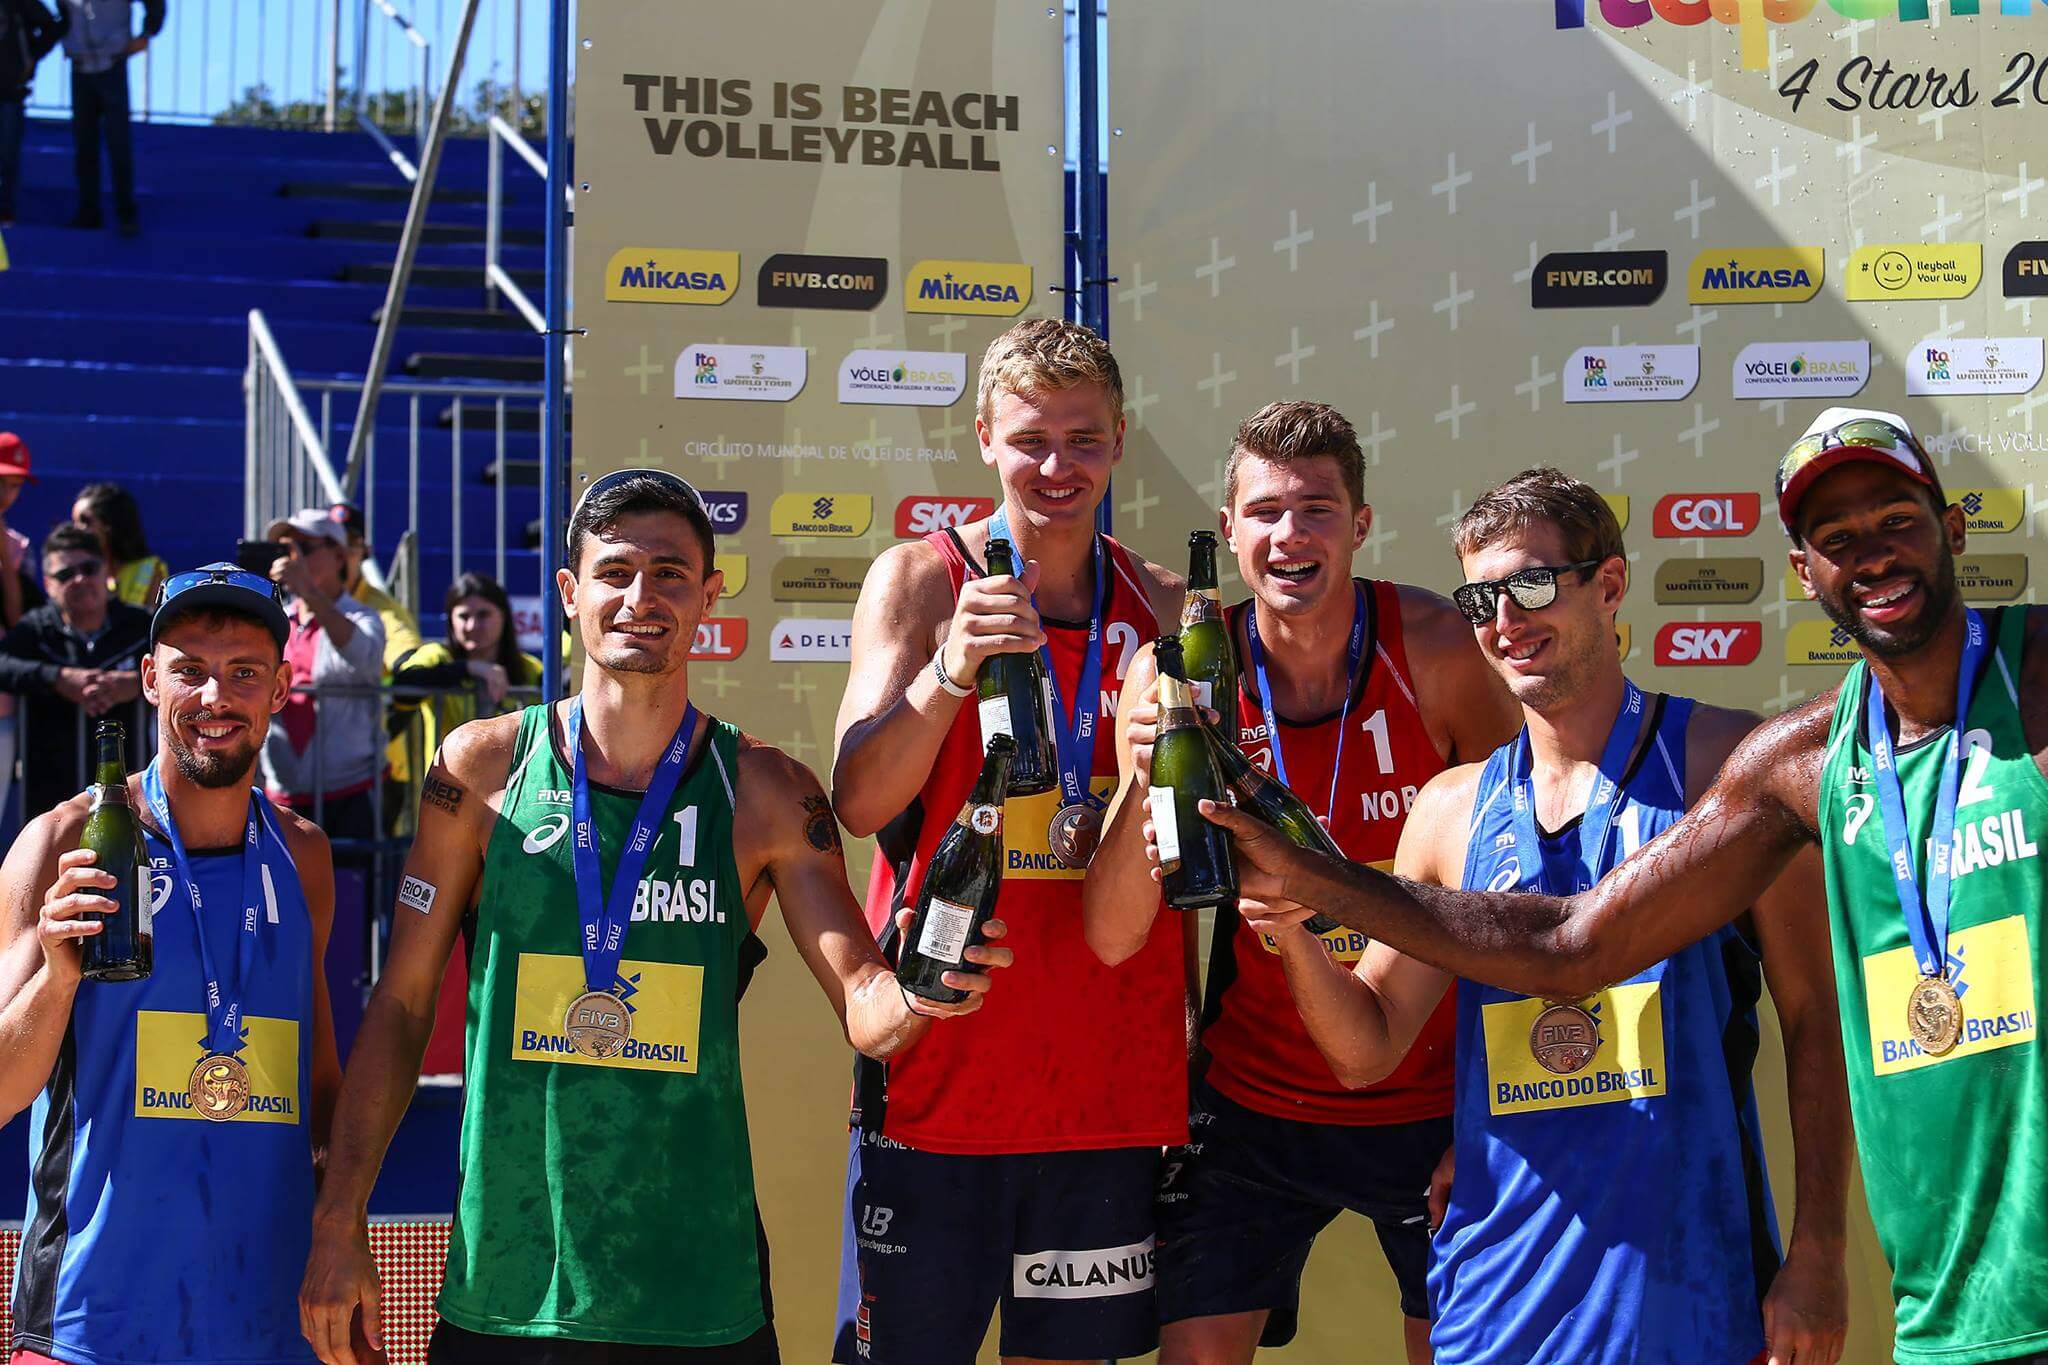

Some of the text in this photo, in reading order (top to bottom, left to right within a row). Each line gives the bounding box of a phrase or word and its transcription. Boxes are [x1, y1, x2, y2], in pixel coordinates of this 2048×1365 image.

[1778, 58, 1820, 113] 4
[1826, 55, 1979, 113] Stars
[622, 73, 1019, 131] THIS IS BEACH
[643, 117, 1000, 172] VOLLEYBALL
[772, 271, 875, 290] FIVB.COM
[1546, 268, 1654, 288] FIVB.COM
[1916, 272, 1967, 285] Your Way
[850, 367, 956, 384] VÔLEI BRASIL
[1744, 361, 1859, 376] VÔLEI BRASIL
[684, 441, 754, 457] CIRCUITO
[757, 444, 825, 460] MUNDIAL
[829, 446, 847, 460] DE
[895, 447, 913, 461] DE
[917, 448, 958, 463] PRAIA
[1924, 433, 1992, 453] BEACH
[706, 503, 738, 522] ICS
[909, 502, 976, 533] SKY
[1670, 499, 1744, 531] GOL
[1978, 520, 2004, 529] BRASIL
[792, 522, 817, 532] BANCO
[829, 523, 853, 533] BRASIL
[782, 580, 827, 589] WORLD
[1666, 582, 1749, 591] WORLD TOUR
[1980, 579, 2013, 587] TOUR
[690, 624, 732, 654] OL
[801, 634, 852, 648] DELT
[1089, 619, 1097, 641] FIVB
[1668, 628, 1742, 660] SKY
[1808, 651, 1835, 660] BANCO
[1631, 690, 1641, 714] FIVB
[1082, 712, 1093, 738] FIVB
[671, 740, 687, 764] FIVB
[1362, 709, 1394, 774] 1
[1960, 728, 1993, 807] 2
[537, 789, 571, 801] FIVB
[1064, 771, 1078, 797] FIVB
[1361, 785, 1418, 820] NOR
[577, 822, 588, 848] FIVB
[634, 827, 651, 852] FIVB
[673, 805, 698, 867] 1
[1612, 805, 1640, 860] 1
[1926, 808, 2038, 882] RASIL
[149, 858, 168, 868] VB
[403, 880, 423, 898] RIO
[244, 907, 256, 933] FIVB
[586, 923, 597, 951] FIVB
[608, 923, 621, 951] FIVB
[208, 980, 220, 1008] FIVB
[579, 1009, 620, 1029] FIVB
[1966, 1010, 2033, 1043] BRASIL
[1543, 1024, 1585, 1041] FIVB
[622, 1039, 688, 1063] BRASIL
[1496, 1068, 1658, 1105] BANCO DO BRASIL
[143, 1087, 192, 1109] BANC
[246, 1095, 293, 1114] RASIL
[1025, 1249, 1155, 1287] CALANUS
